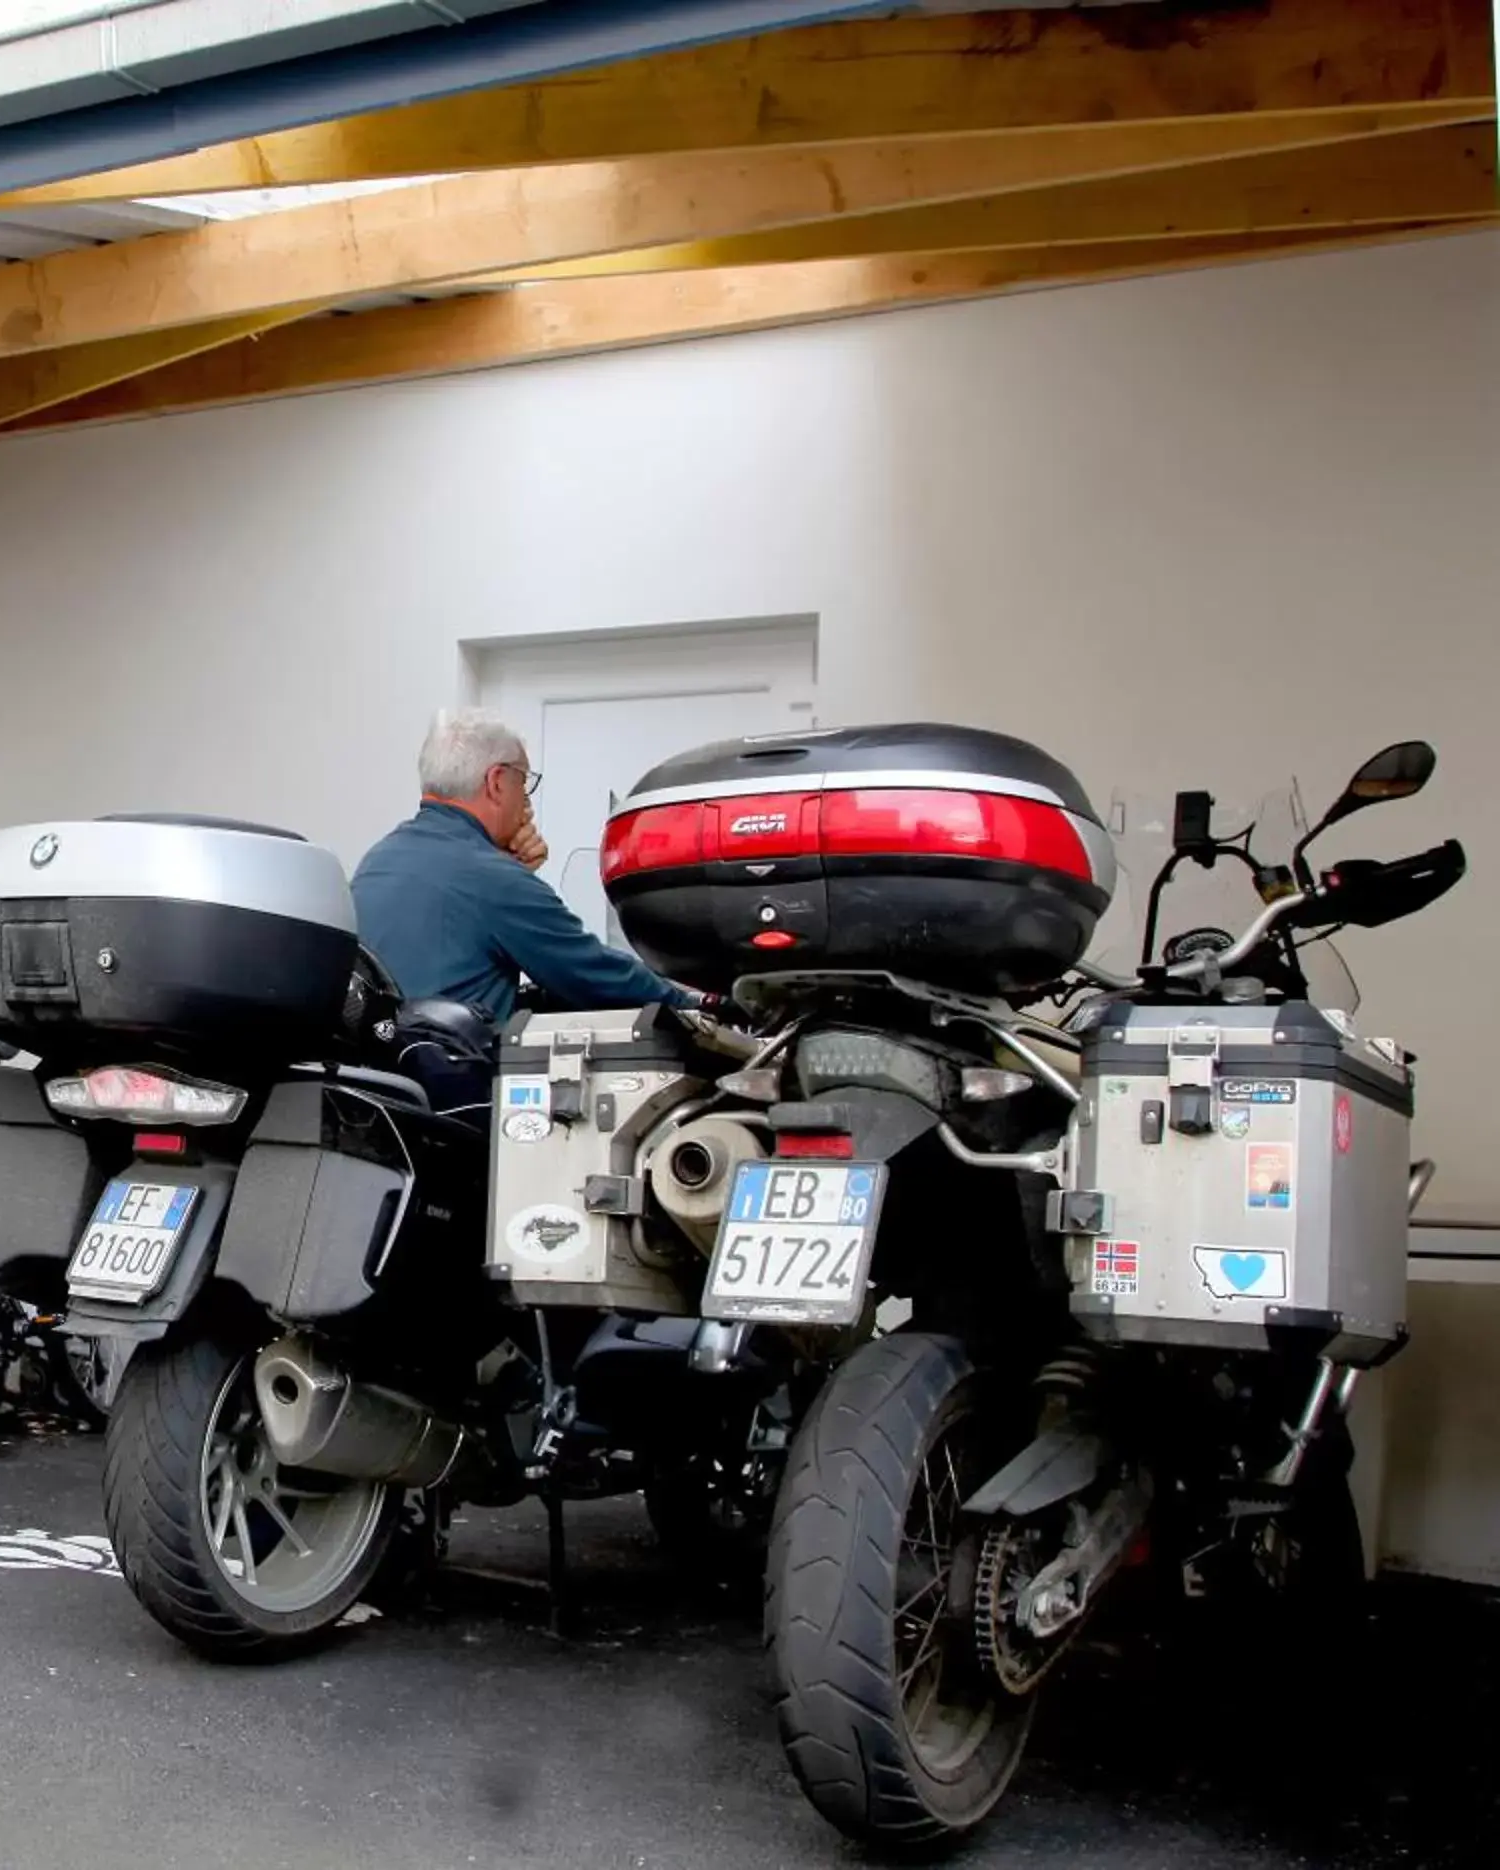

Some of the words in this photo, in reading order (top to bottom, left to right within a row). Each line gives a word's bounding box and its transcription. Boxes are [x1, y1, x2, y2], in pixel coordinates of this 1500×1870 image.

[1223, 1081, 1291, 1093] GoPro
[117, 1185, 161, 1222] EF
[763, 1169, 820, 1219] EB
[79, 1232, 165, 1276] 81600
[721, 1235, 859, 1289] 51724
